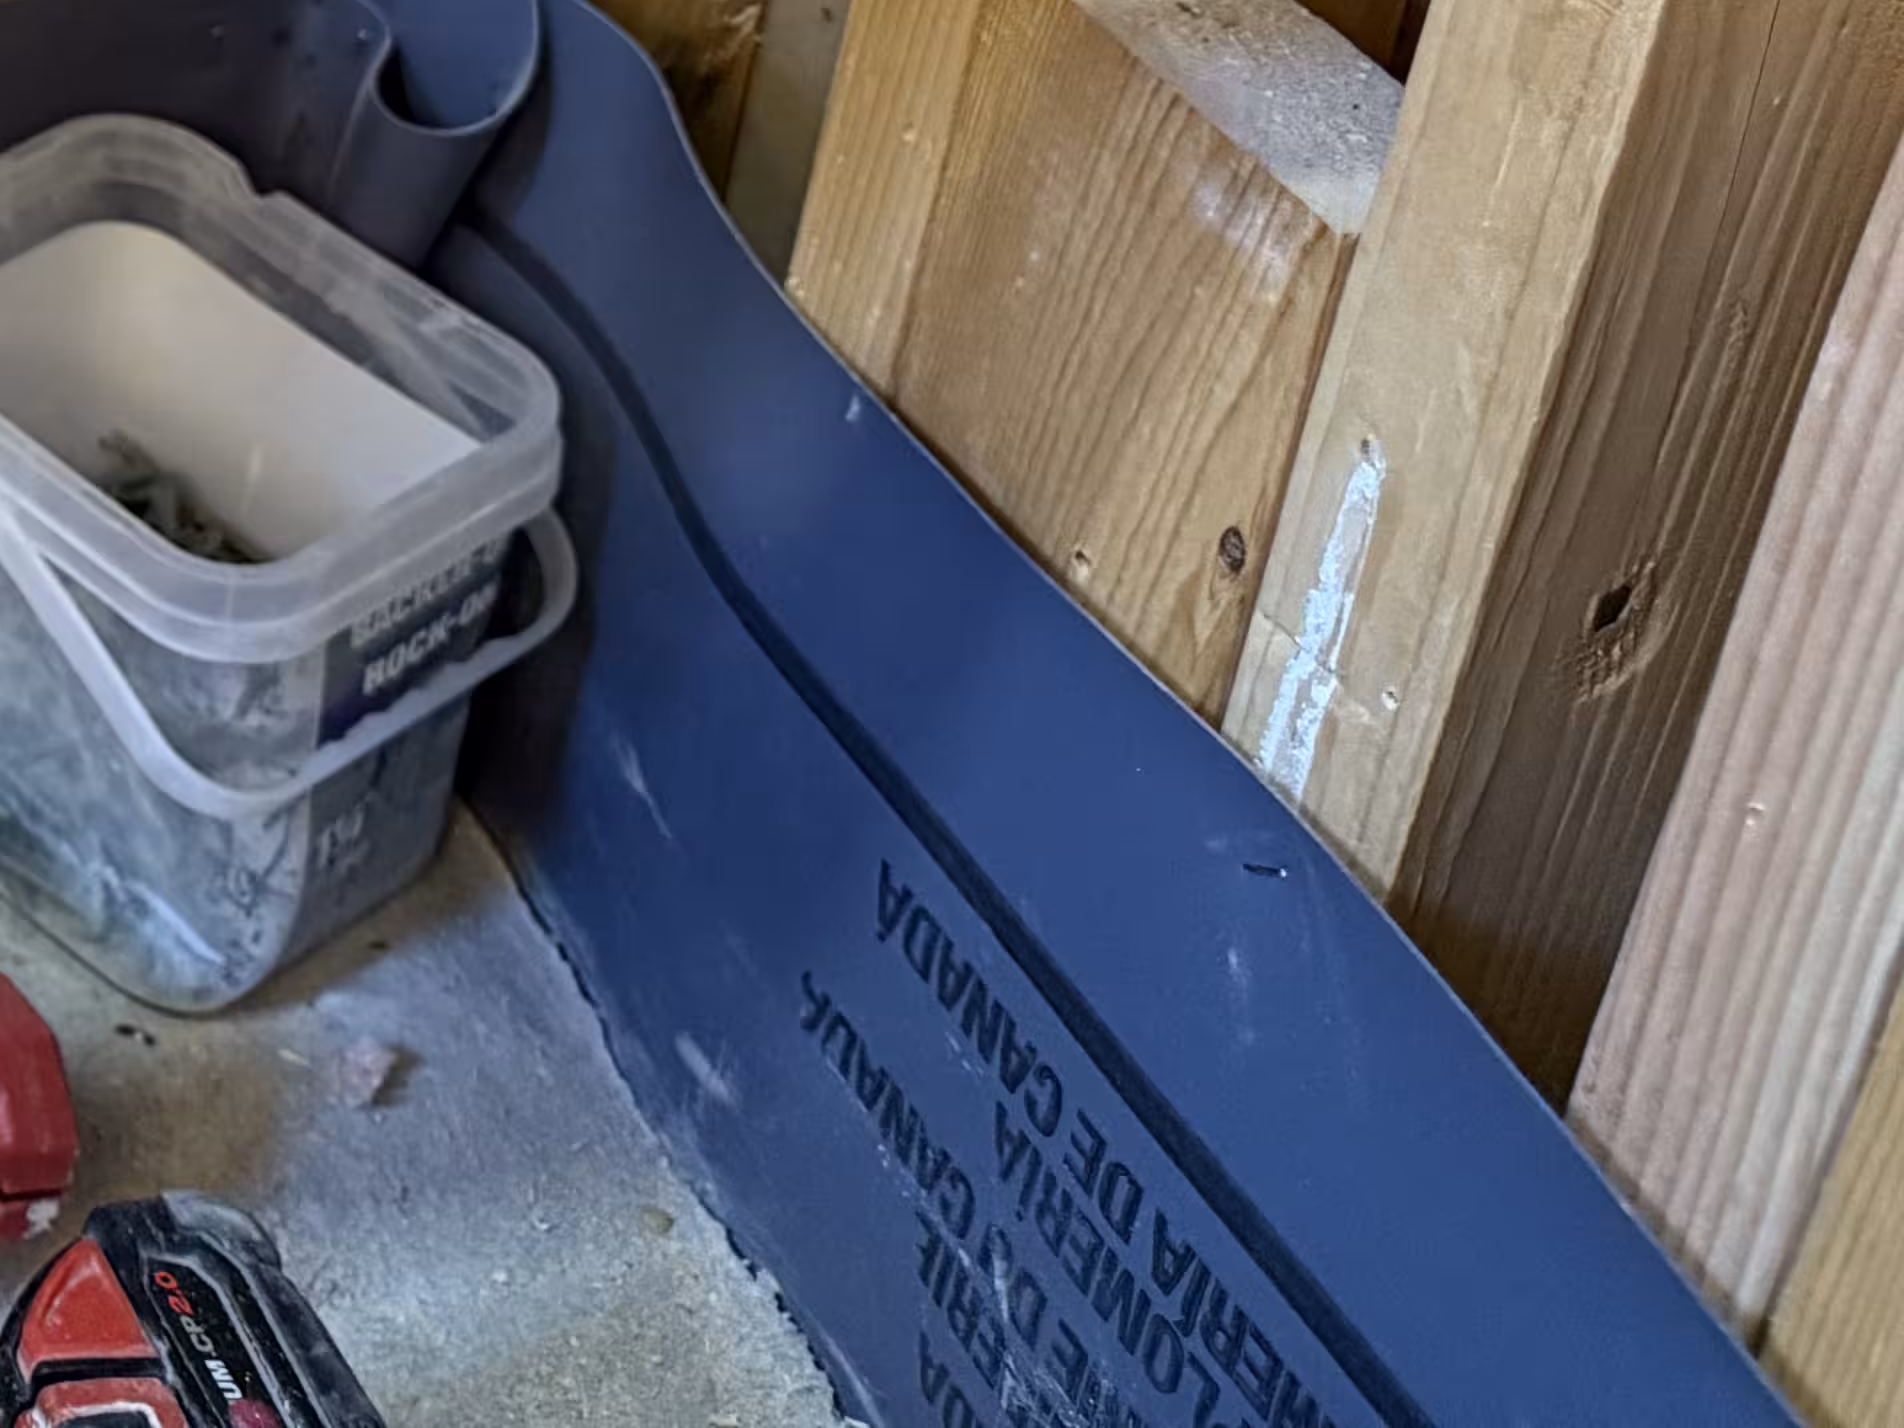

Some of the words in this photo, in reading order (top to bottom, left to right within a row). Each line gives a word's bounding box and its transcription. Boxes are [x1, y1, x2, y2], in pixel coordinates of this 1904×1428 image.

[1064, 1108, 1146, 1245] DE
[995, 1101, 1252, 1428] LOMERÍA
[204, 1359, 243, 1406] UM
